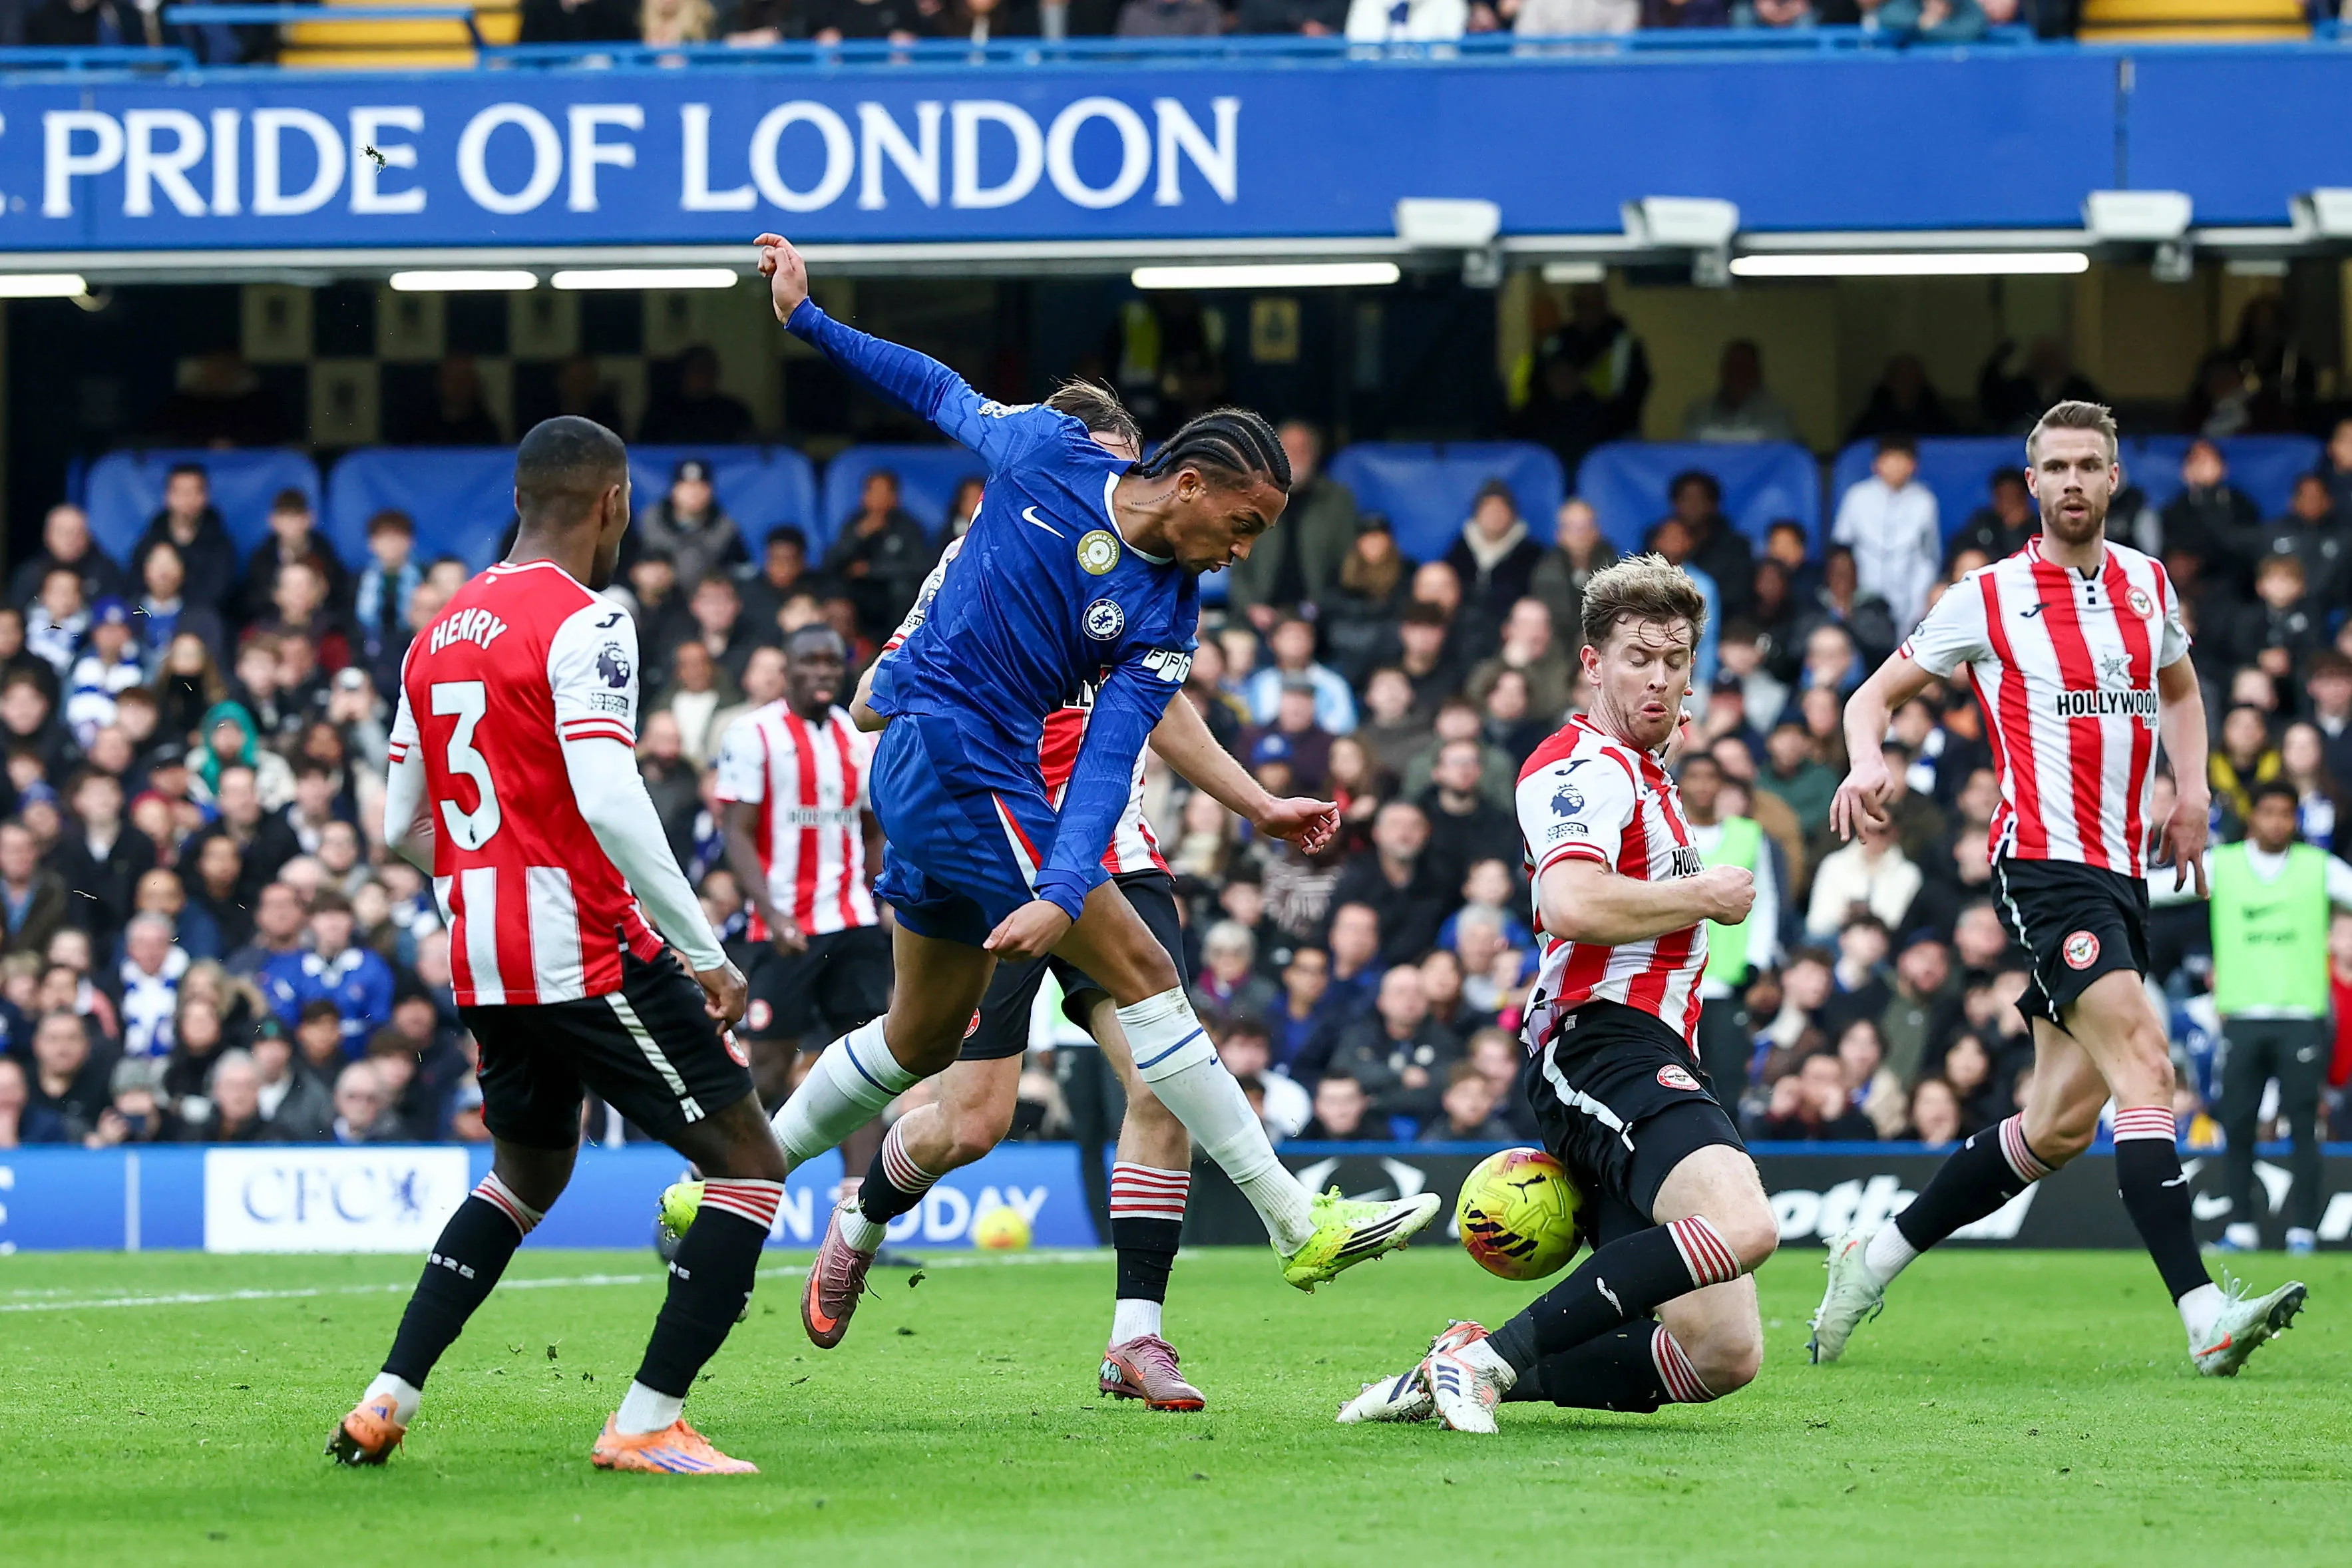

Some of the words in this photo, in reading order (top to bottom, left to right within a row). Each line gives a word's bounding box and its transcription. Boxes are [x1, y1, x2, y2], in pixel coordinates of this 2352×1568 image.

[42, 104, 427, 219] PRIDE
[457, 101, 646, 215] OF
[680, 96, 1243, 214] LONDON
[1079, 552, 1093, 570] FIFA
[1086, 534, 1107, 544] WORLD
[1101, 538, 1117, 571] CHAMPIONS
[430, 607, 508, 656] HENRY
[1105, 601, 1123, 626] CHELSEA
[1147, 648, 1191, 678] FPT
[2056, 691, 2158, 717] HOLLYWOOD
[431, 680, 502, 852] 3
[242, 1165, 378, 1225] CFC
